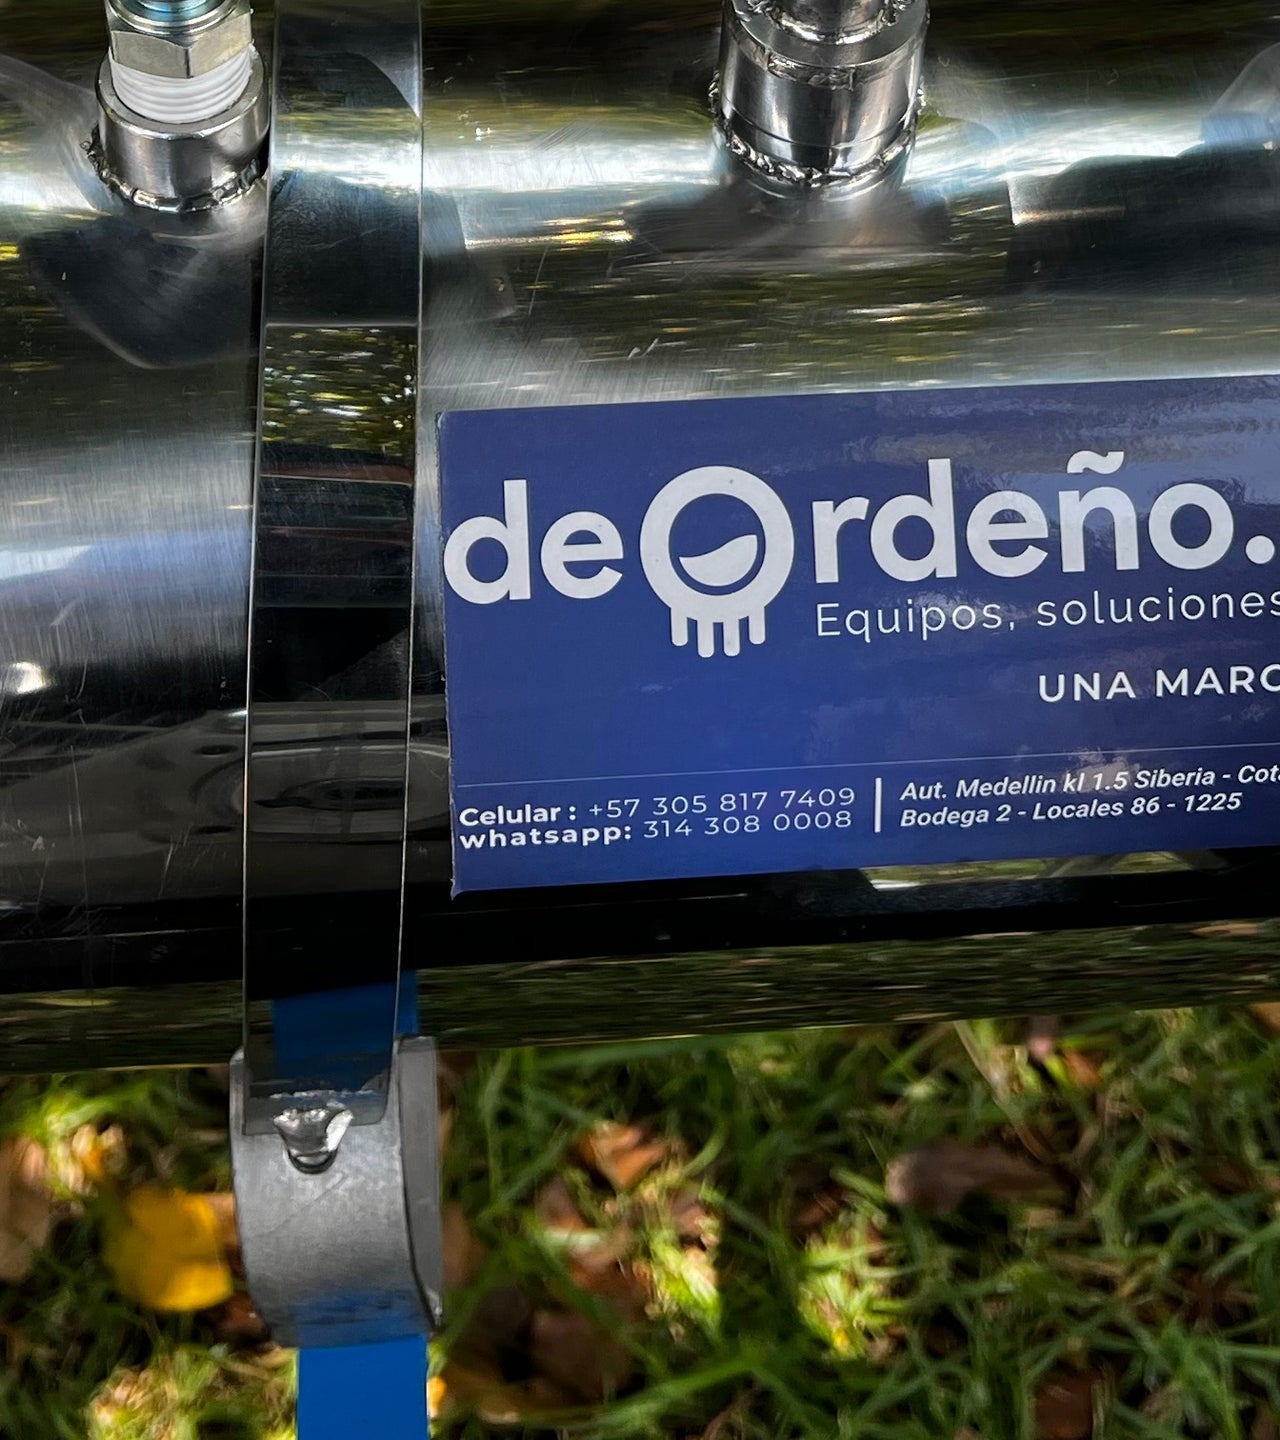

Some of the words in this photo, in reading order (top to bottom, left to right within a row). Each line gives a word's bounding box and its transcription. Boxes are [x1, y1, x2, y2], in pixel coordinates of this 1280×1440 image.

[816, 598, 1016, 644] Equipos,
[1038, 670, 1136, 703] UNA
[899, 781, 947, 801] Aut.
[955, 775, 1057, 799] Medellin
[1062, 771, 1084, 792] kl
[1092, 770, 1128, 792] 1.5
[1134, 766, 1215, 790] Siberia
[588, 798, 641, 819] +57
[652, 794, 707, 816] 305
[719, 791, 769, 812] 817
[779, 787, 856, 810] 7409
[899, 805, 989, 828] Bodega
[994, 803, 1011, 822] 2
[1032, 798, 1124, 821] Locales
[1129, 796, 1161, 816] 86
[1184, 791, 1243, 813] 1225
[458, 823, 632, 850] whatsapp:
[643, 818, 693, 839] 314
[703, 814, 761, 835] 308
[772, 810, 852, 832] 0008
